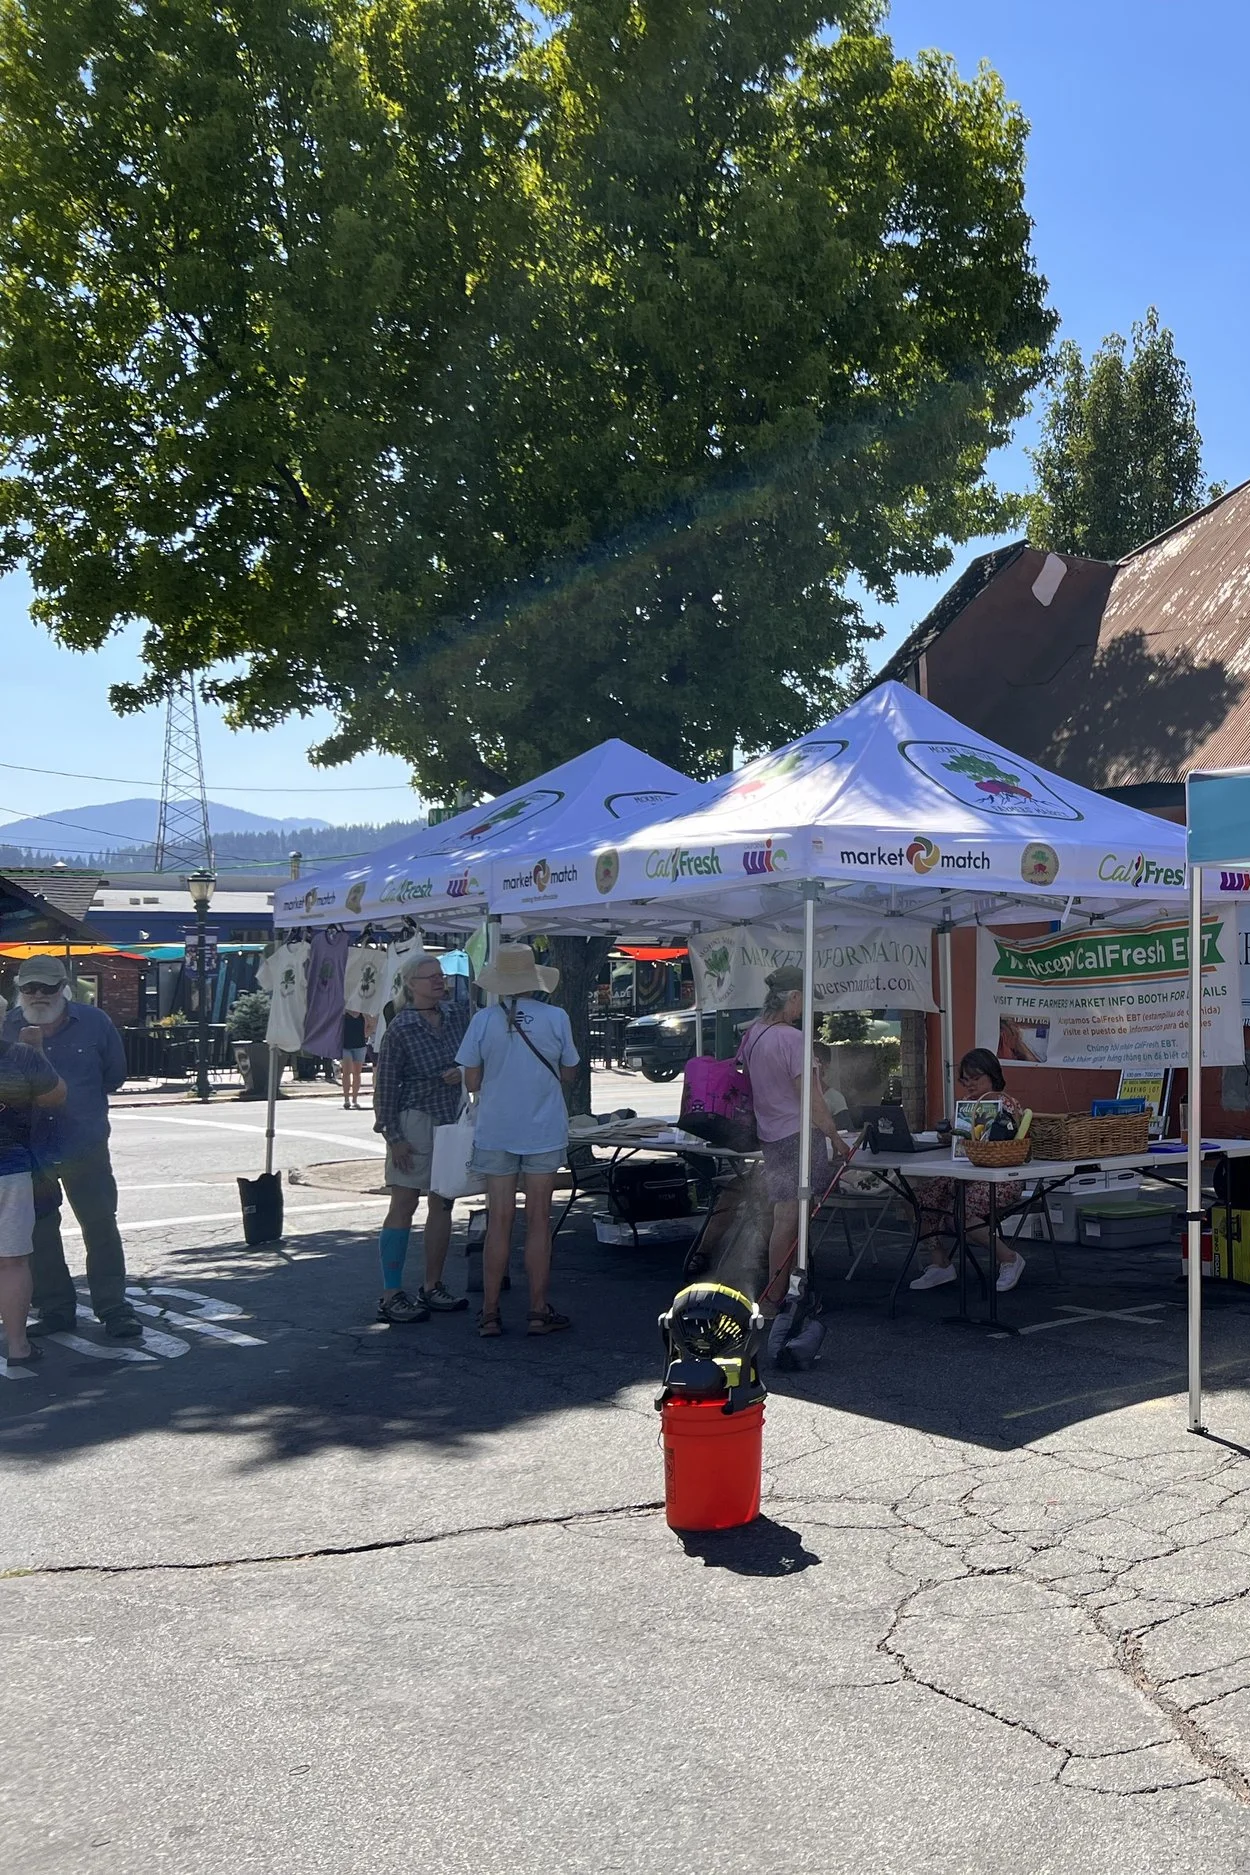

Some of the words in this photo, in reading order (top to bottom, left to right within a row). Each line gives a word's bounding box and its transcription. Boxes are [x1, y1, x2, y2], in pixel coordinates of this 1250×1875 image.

[841, 846, 904, 866] market
[941, 850, 990, 870] match
[503, 871, 533, 891] market
[550, 863, 578, 884] match
[1171, 932, 1213, 962] ET
[1016, 996, 1036, 1008] THE
[1069, 997, 1106, 1009] MARKET
[1108, 995, 1135, 1007] INFO
[1138, 993, 1168, 1005] BOOTH
[1170, 990, 1186, 1002] FOR
[1092, 1014, 1124, 1024] CalFresh
[1126, 1013, 1142, 1023] EBT
[1063, 1028, 1081, 1036] Visite
[1082, 1028, 1090, 1036] el
[1091, 1027, 1116, 1037] puesto
[1117, 1026, 1128, 1035] de
